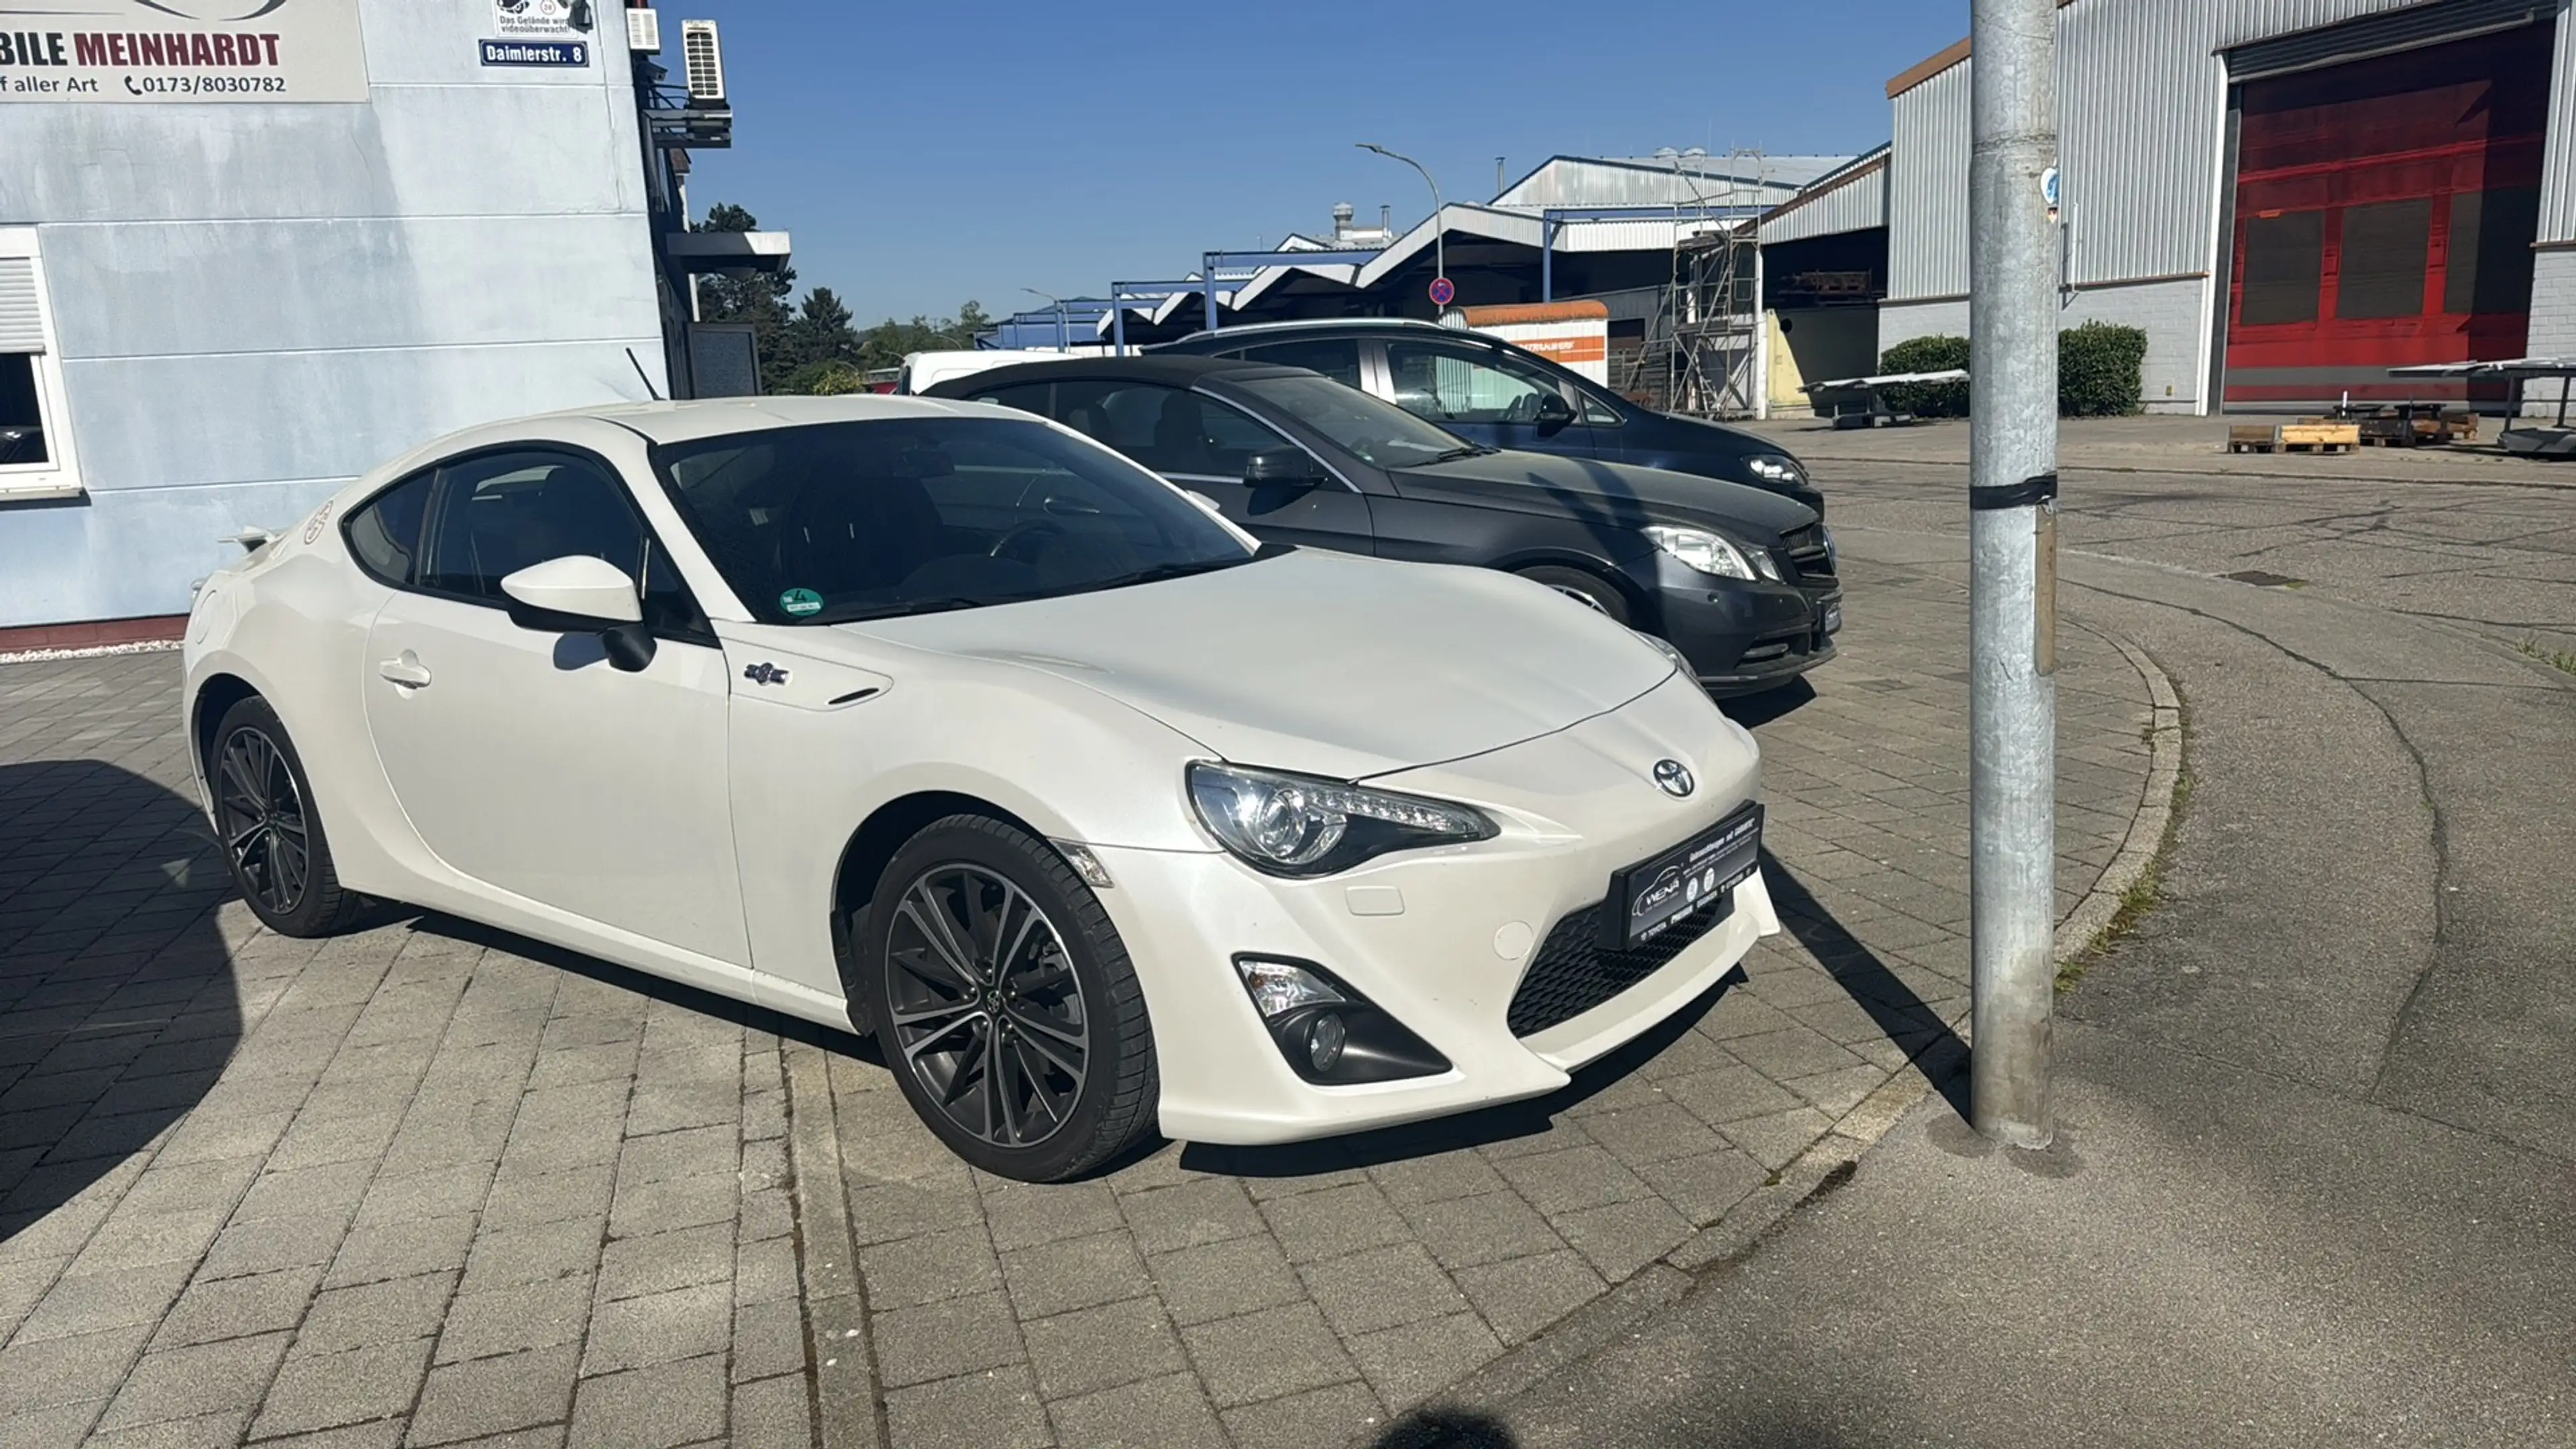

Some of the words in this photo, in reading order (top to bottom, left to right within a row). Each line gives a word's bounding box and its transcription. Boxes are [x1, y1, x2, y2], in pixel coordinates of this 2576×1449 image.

[500, 16, 516, 24] Das
[517, 16, 550, 25] Gelände
[74, 34, 280, 66] MEINHARDT
[486, 45, 566, 62] Daimlerstr.
[573, 47, 582, 62] 8
[14, 76, 60, 92] aller
[66, 77, 99, 93] Art
[143, 76, 286, 95] 0173/8030782
